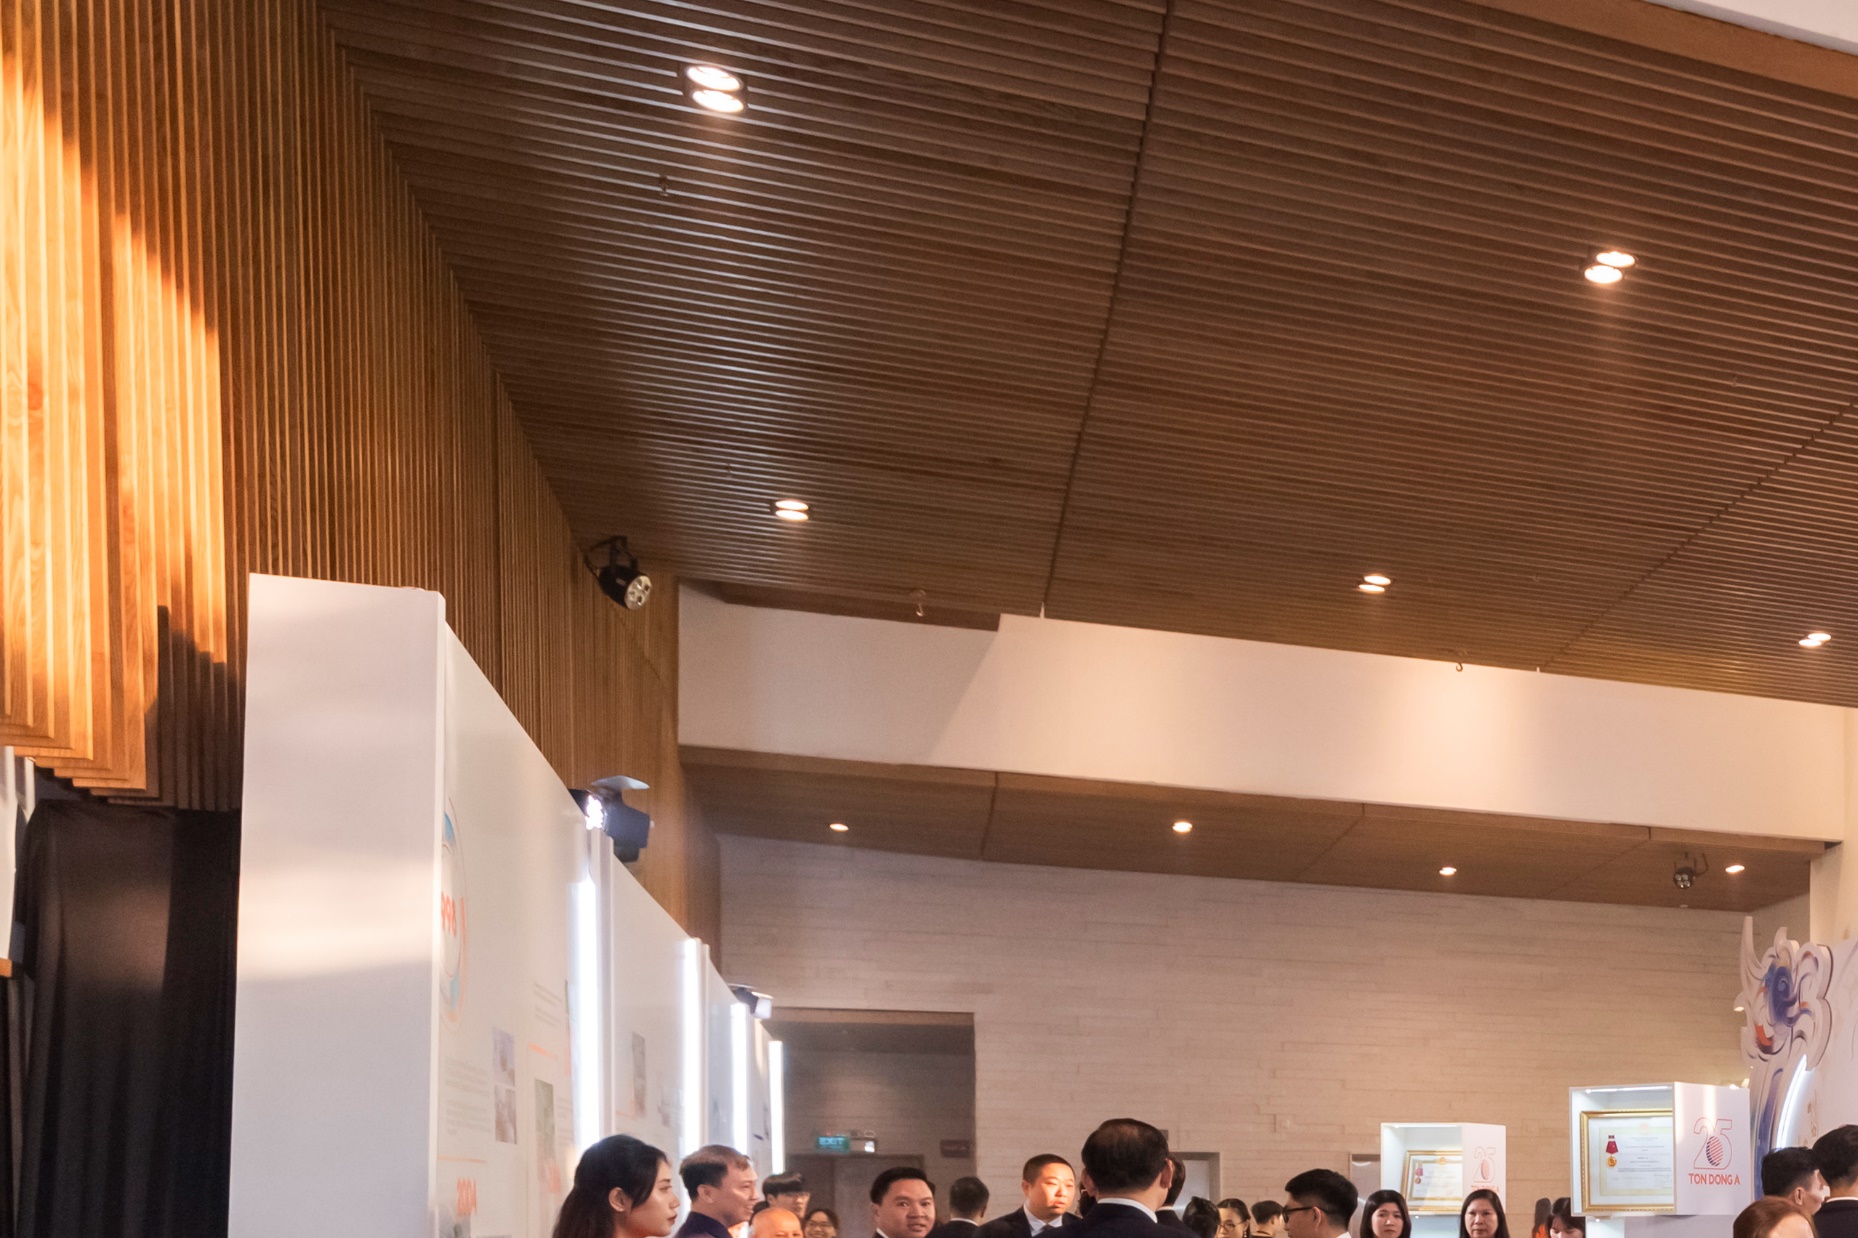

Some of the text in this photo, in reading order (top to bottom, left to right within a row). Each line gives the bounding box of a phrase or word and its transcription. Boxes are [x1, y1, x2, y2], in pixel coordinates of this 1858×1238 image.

[819, 1137, 845, 1146] EXIT
[1694, 1117, 1732, 1170] 25
[1474, 1146, 1496, 1183] 25
[1688, 1173, 1740, 1185] TON DONG A
